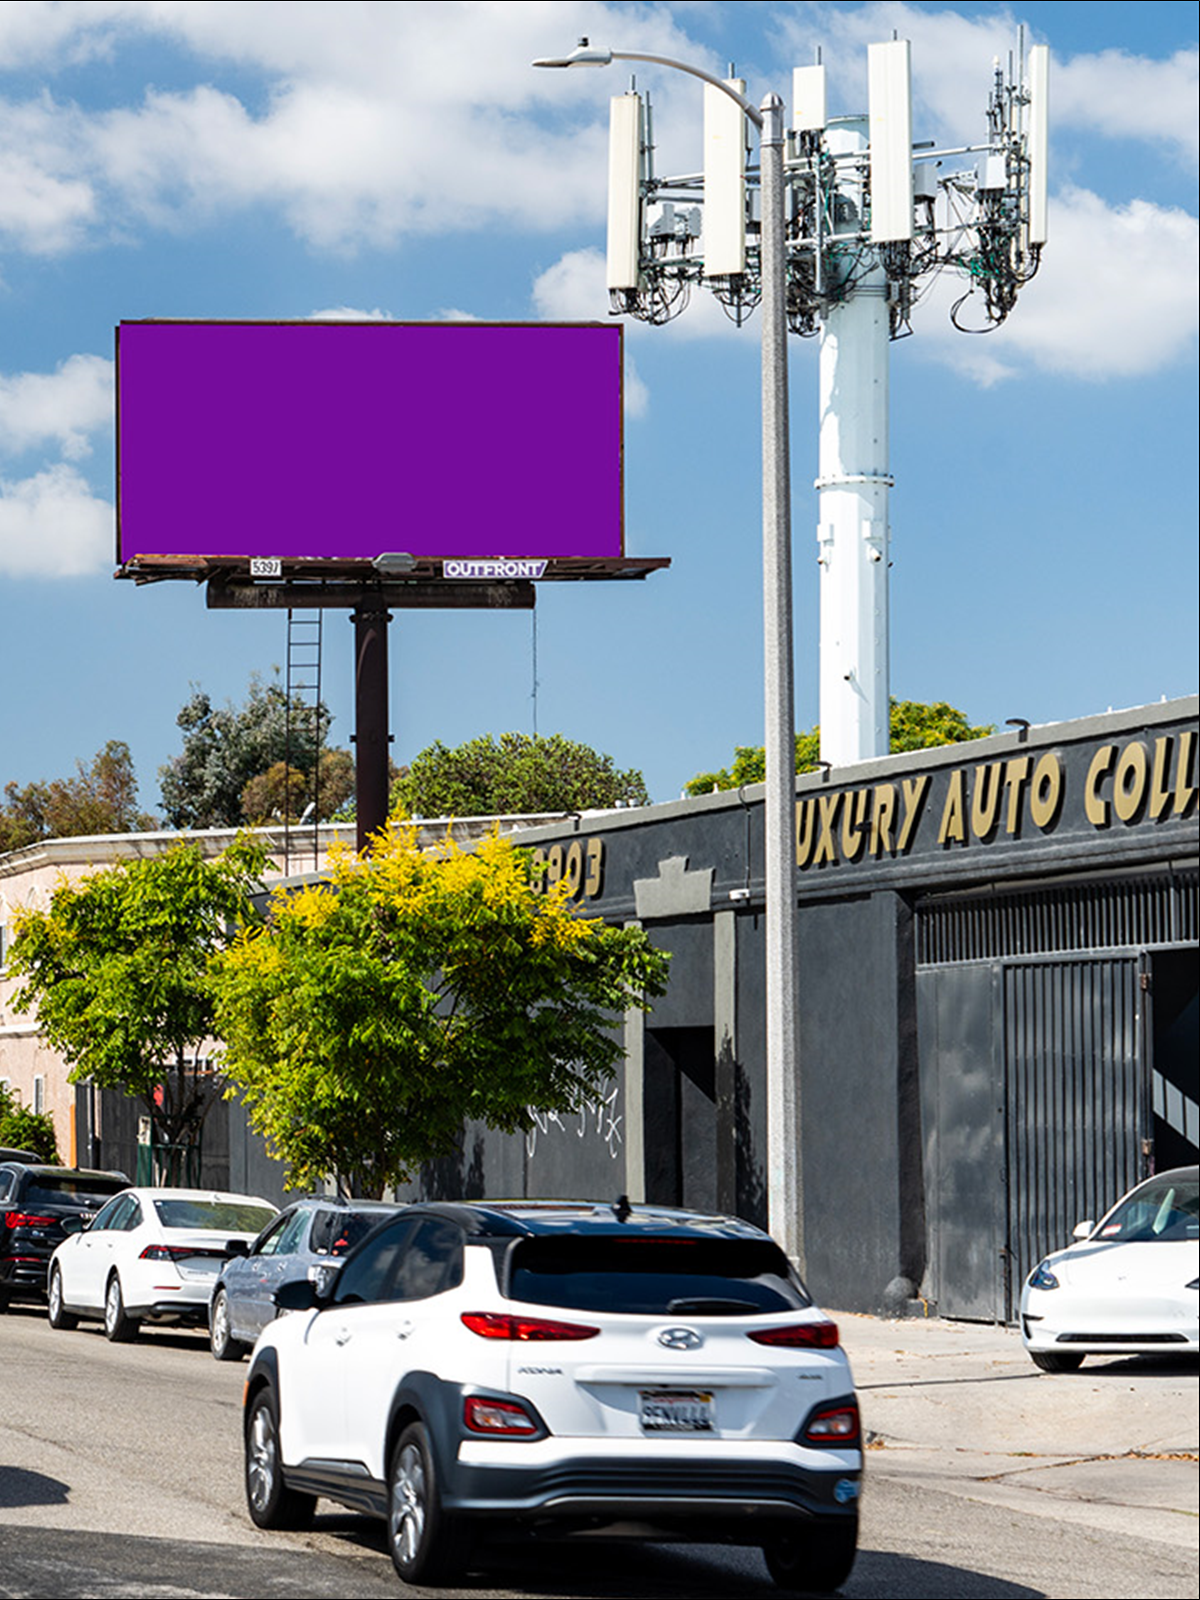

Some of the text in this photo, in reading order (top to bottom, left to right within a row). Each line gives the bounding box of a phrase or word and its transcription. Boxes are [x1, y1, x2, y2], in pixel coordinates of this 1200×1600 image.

[252, 561, 279, 574] 5397
[446, 561, 542, 577] OUTFRONT
[796, 731, 1198, 866] UXURY AUTO COLL
